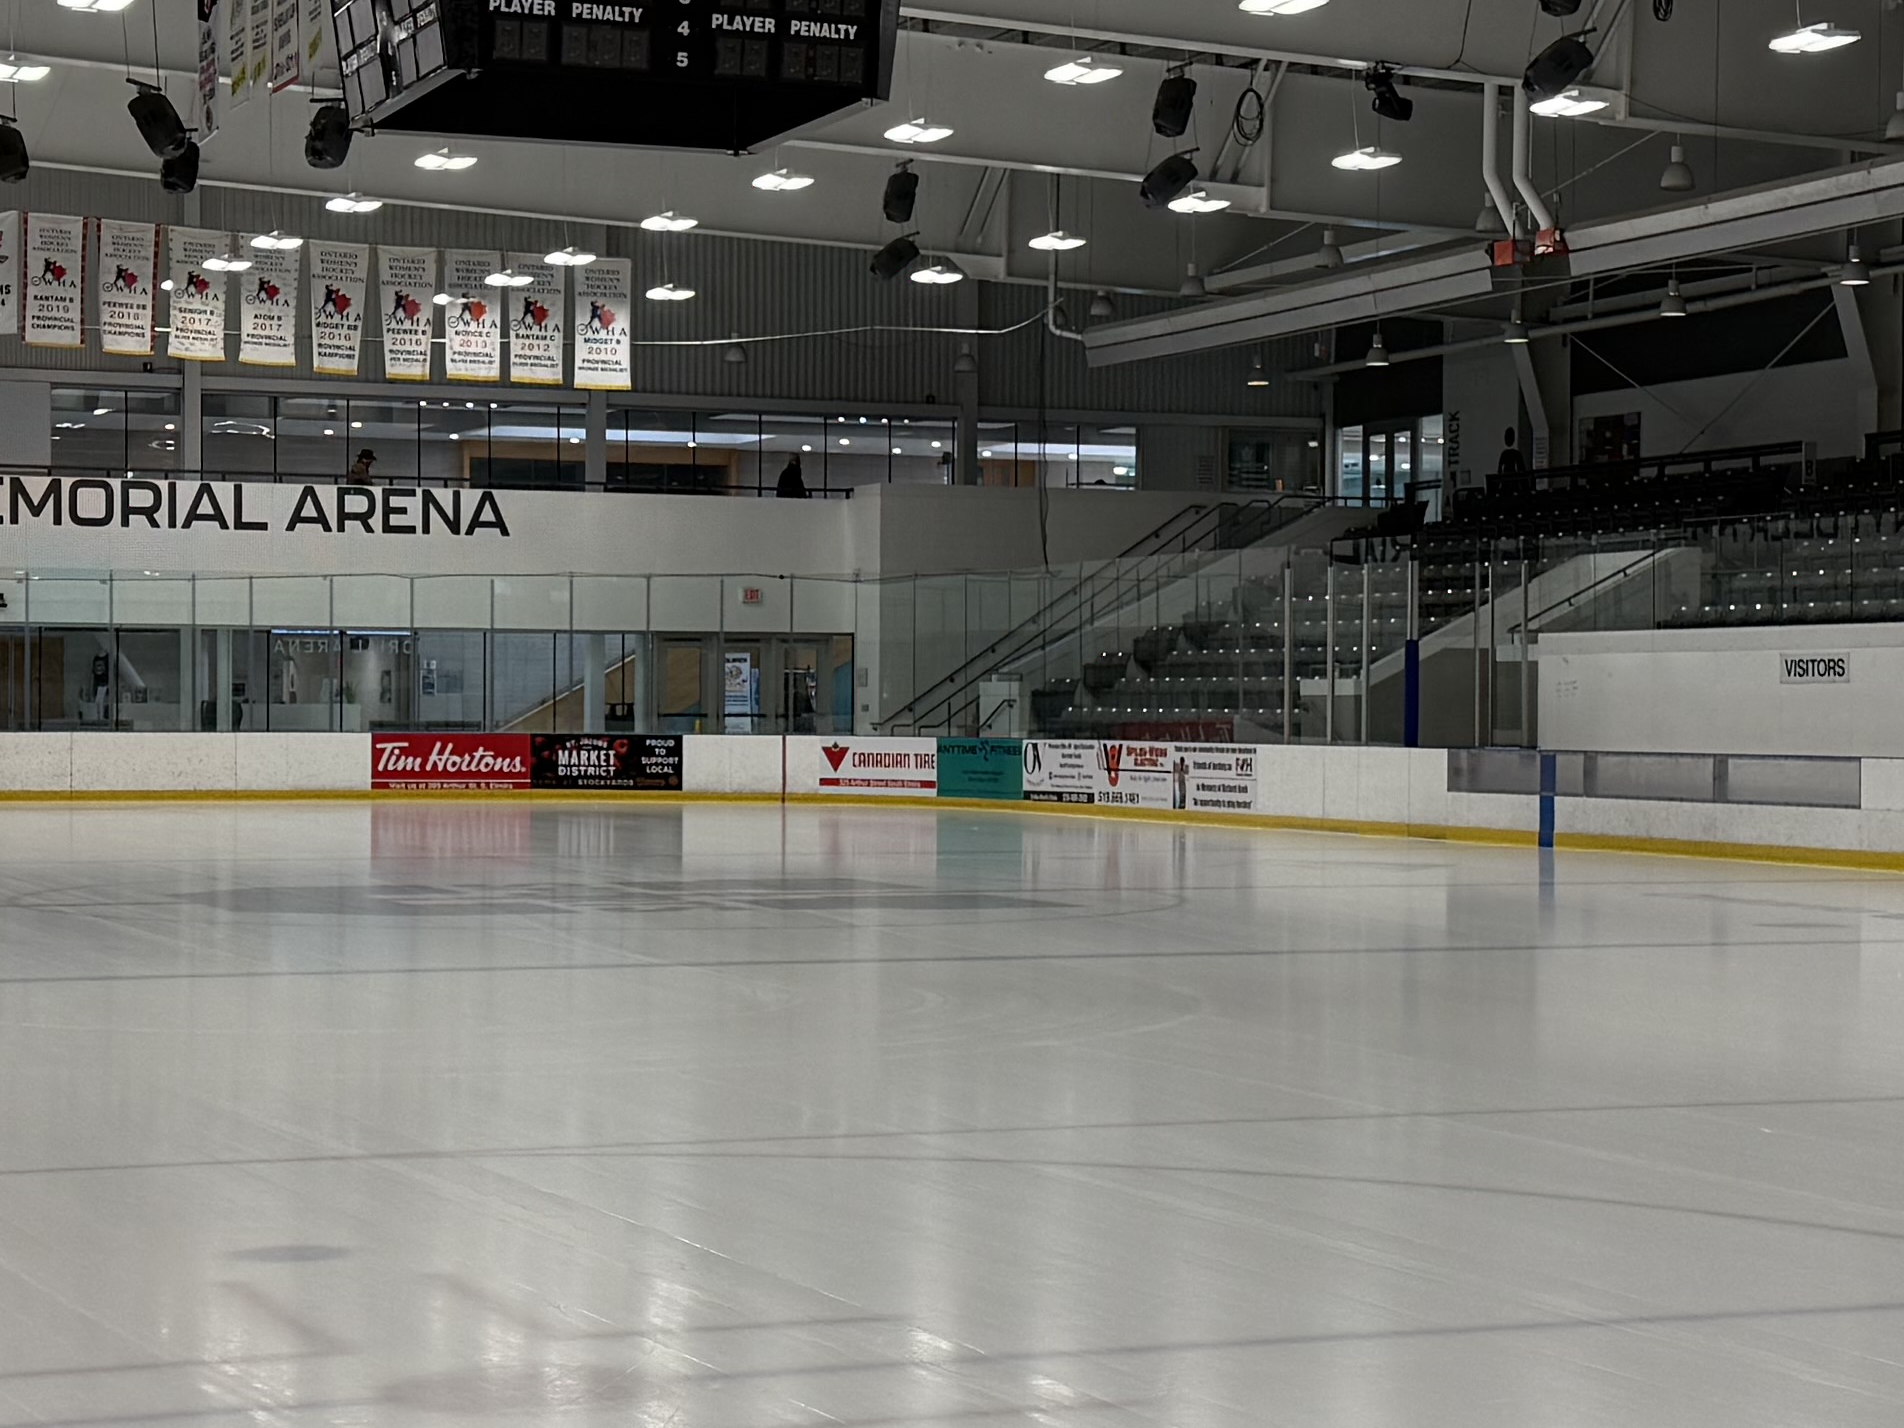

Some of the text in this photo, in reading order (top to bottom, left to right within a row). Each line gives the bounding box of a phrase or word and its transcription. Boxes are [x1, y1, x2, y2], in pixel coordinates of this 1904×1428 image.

[572, 2, 643, 23] PENALTY
[677, 21, 690, 36] 4
[711, 13, 858, 40] PLAYER PENALTY
[676, 52, 688, 67] 5
[1448, 410, 1460, 466] TRACK
[285, 487, 511, 537] ARENA
[1784, 658, 1846, 678] VISITORS
[376, 741, 421, 772] Tim
[558, 750, 616, 766] MARKET
[853, 752, 935, 770] CANADIAN TIRE
[558, 767, 616, 776] DISTRICT
